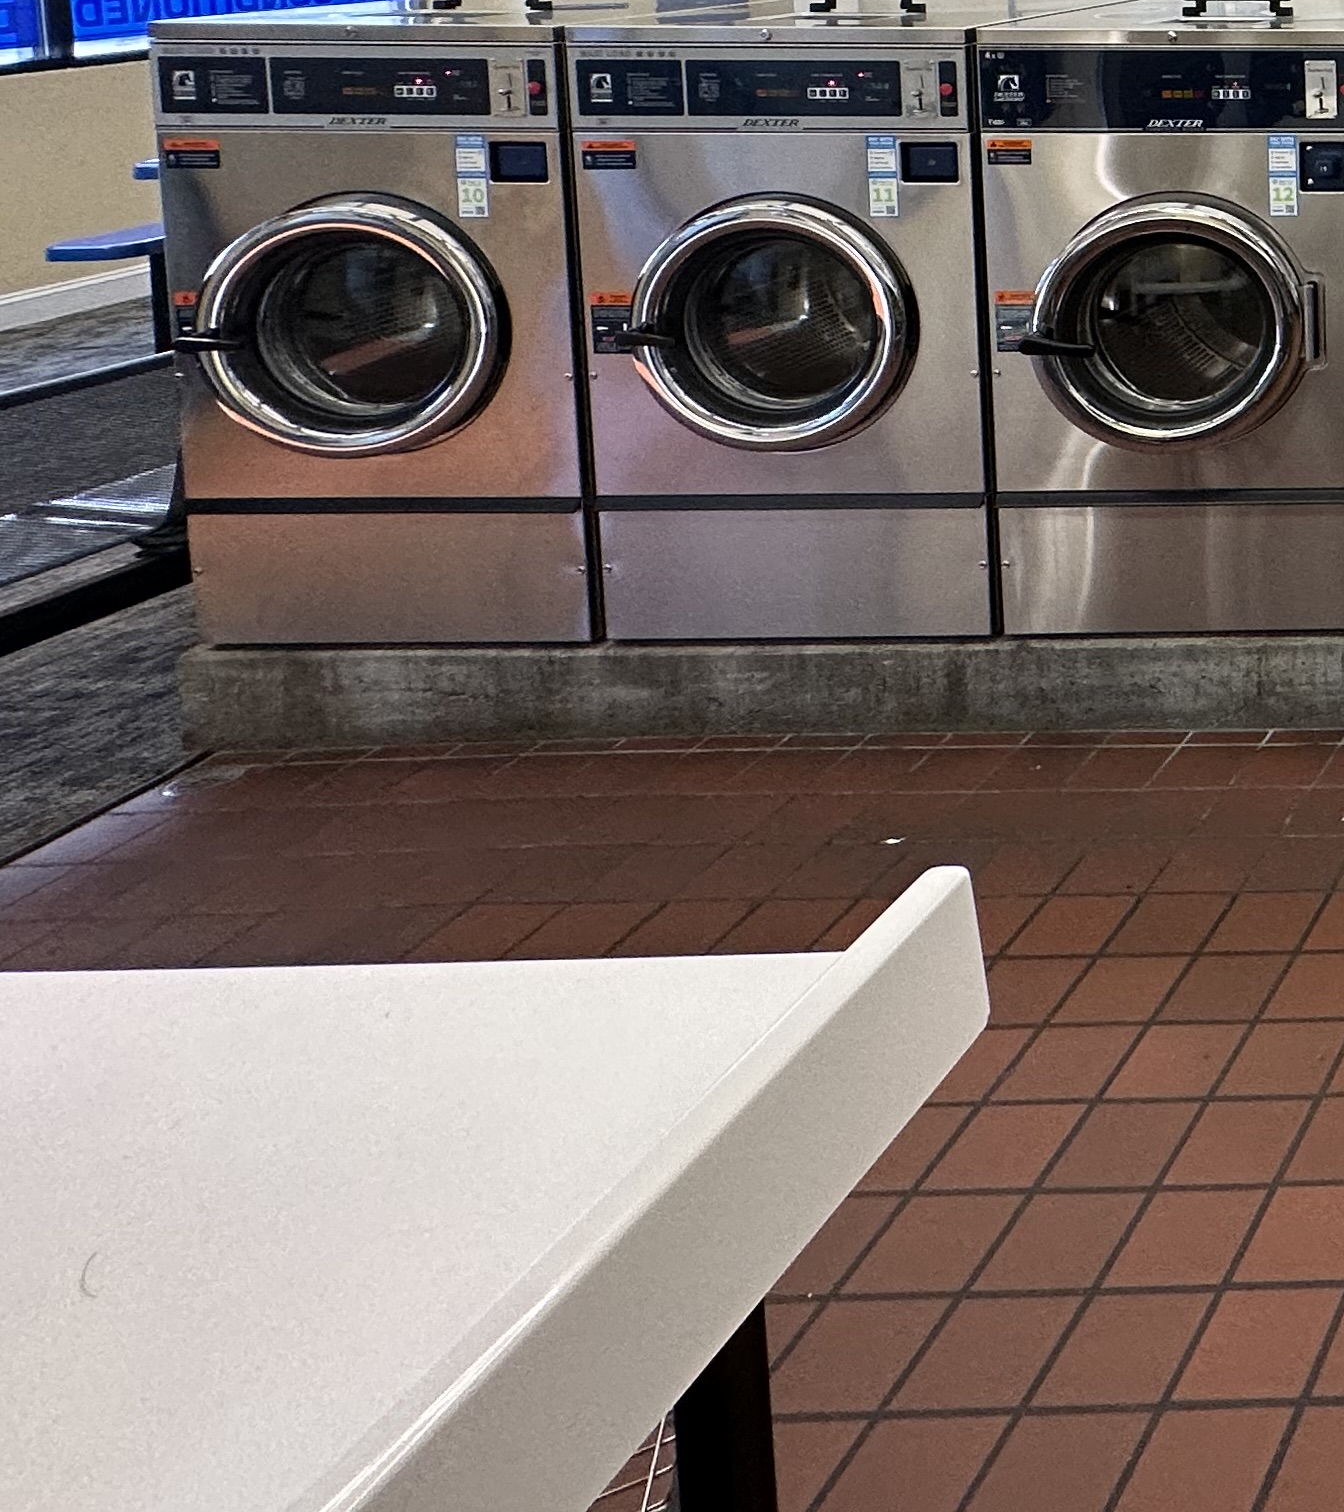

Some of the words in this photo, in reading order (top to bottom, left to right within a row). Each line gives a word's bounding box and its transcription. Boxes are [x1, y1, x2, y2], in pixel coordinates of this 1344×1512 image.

[329, 116, 388, 126] DEXTER
[742, 118, 800, 128] DEXTER
[1147, 119, 1204, 128] DEXTER
[461, 188, 485, 203] 10
[872, 188, 895, 202] 11
[1272, 187, 1295, 202] 12
